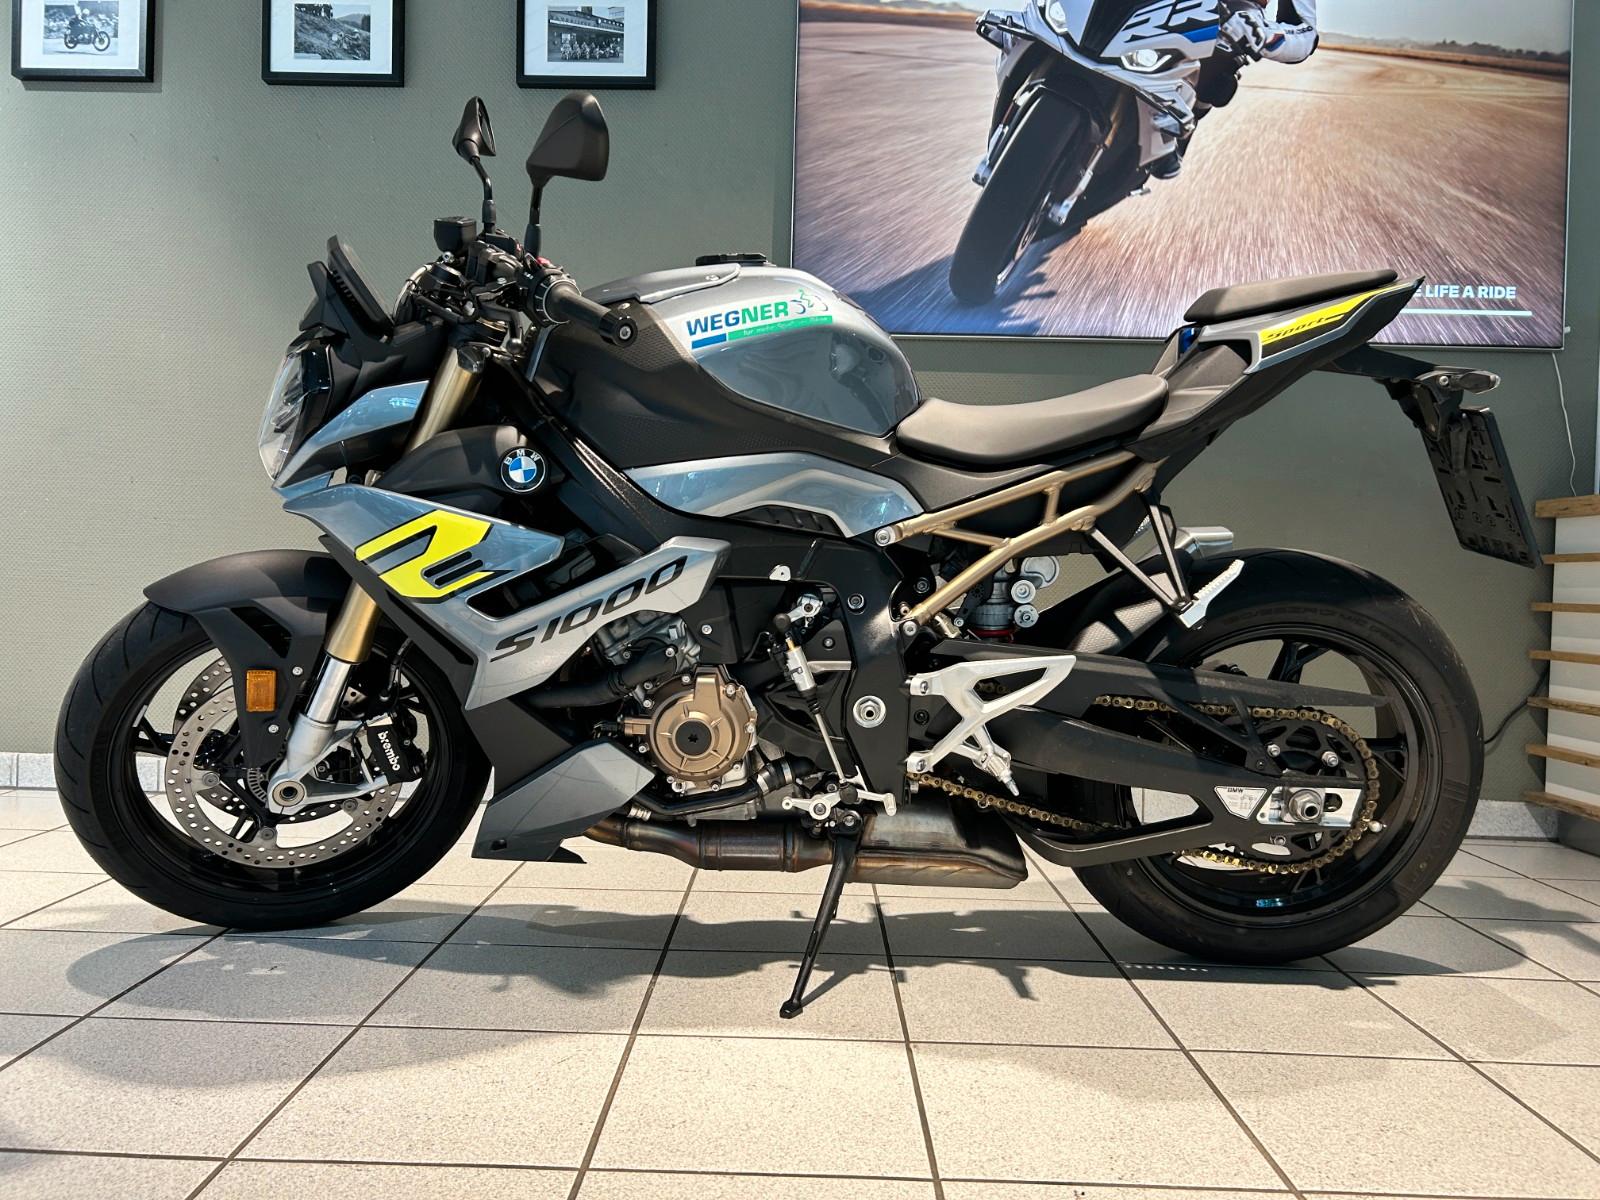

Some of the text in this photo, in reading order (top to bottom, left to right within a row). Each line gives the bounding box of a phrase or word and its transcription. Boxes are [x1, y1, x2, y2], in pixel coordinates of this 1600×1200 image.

[1425, 285, 1460, 298] LIFE
[1462, 286, 1475, 298] A
[1477, 285, 1517, 299] RIDE
[686, 301, 788, 336] WEGNER
[504, 448, 541, 465] BMW
[377, 731, 400, 771] brembo
